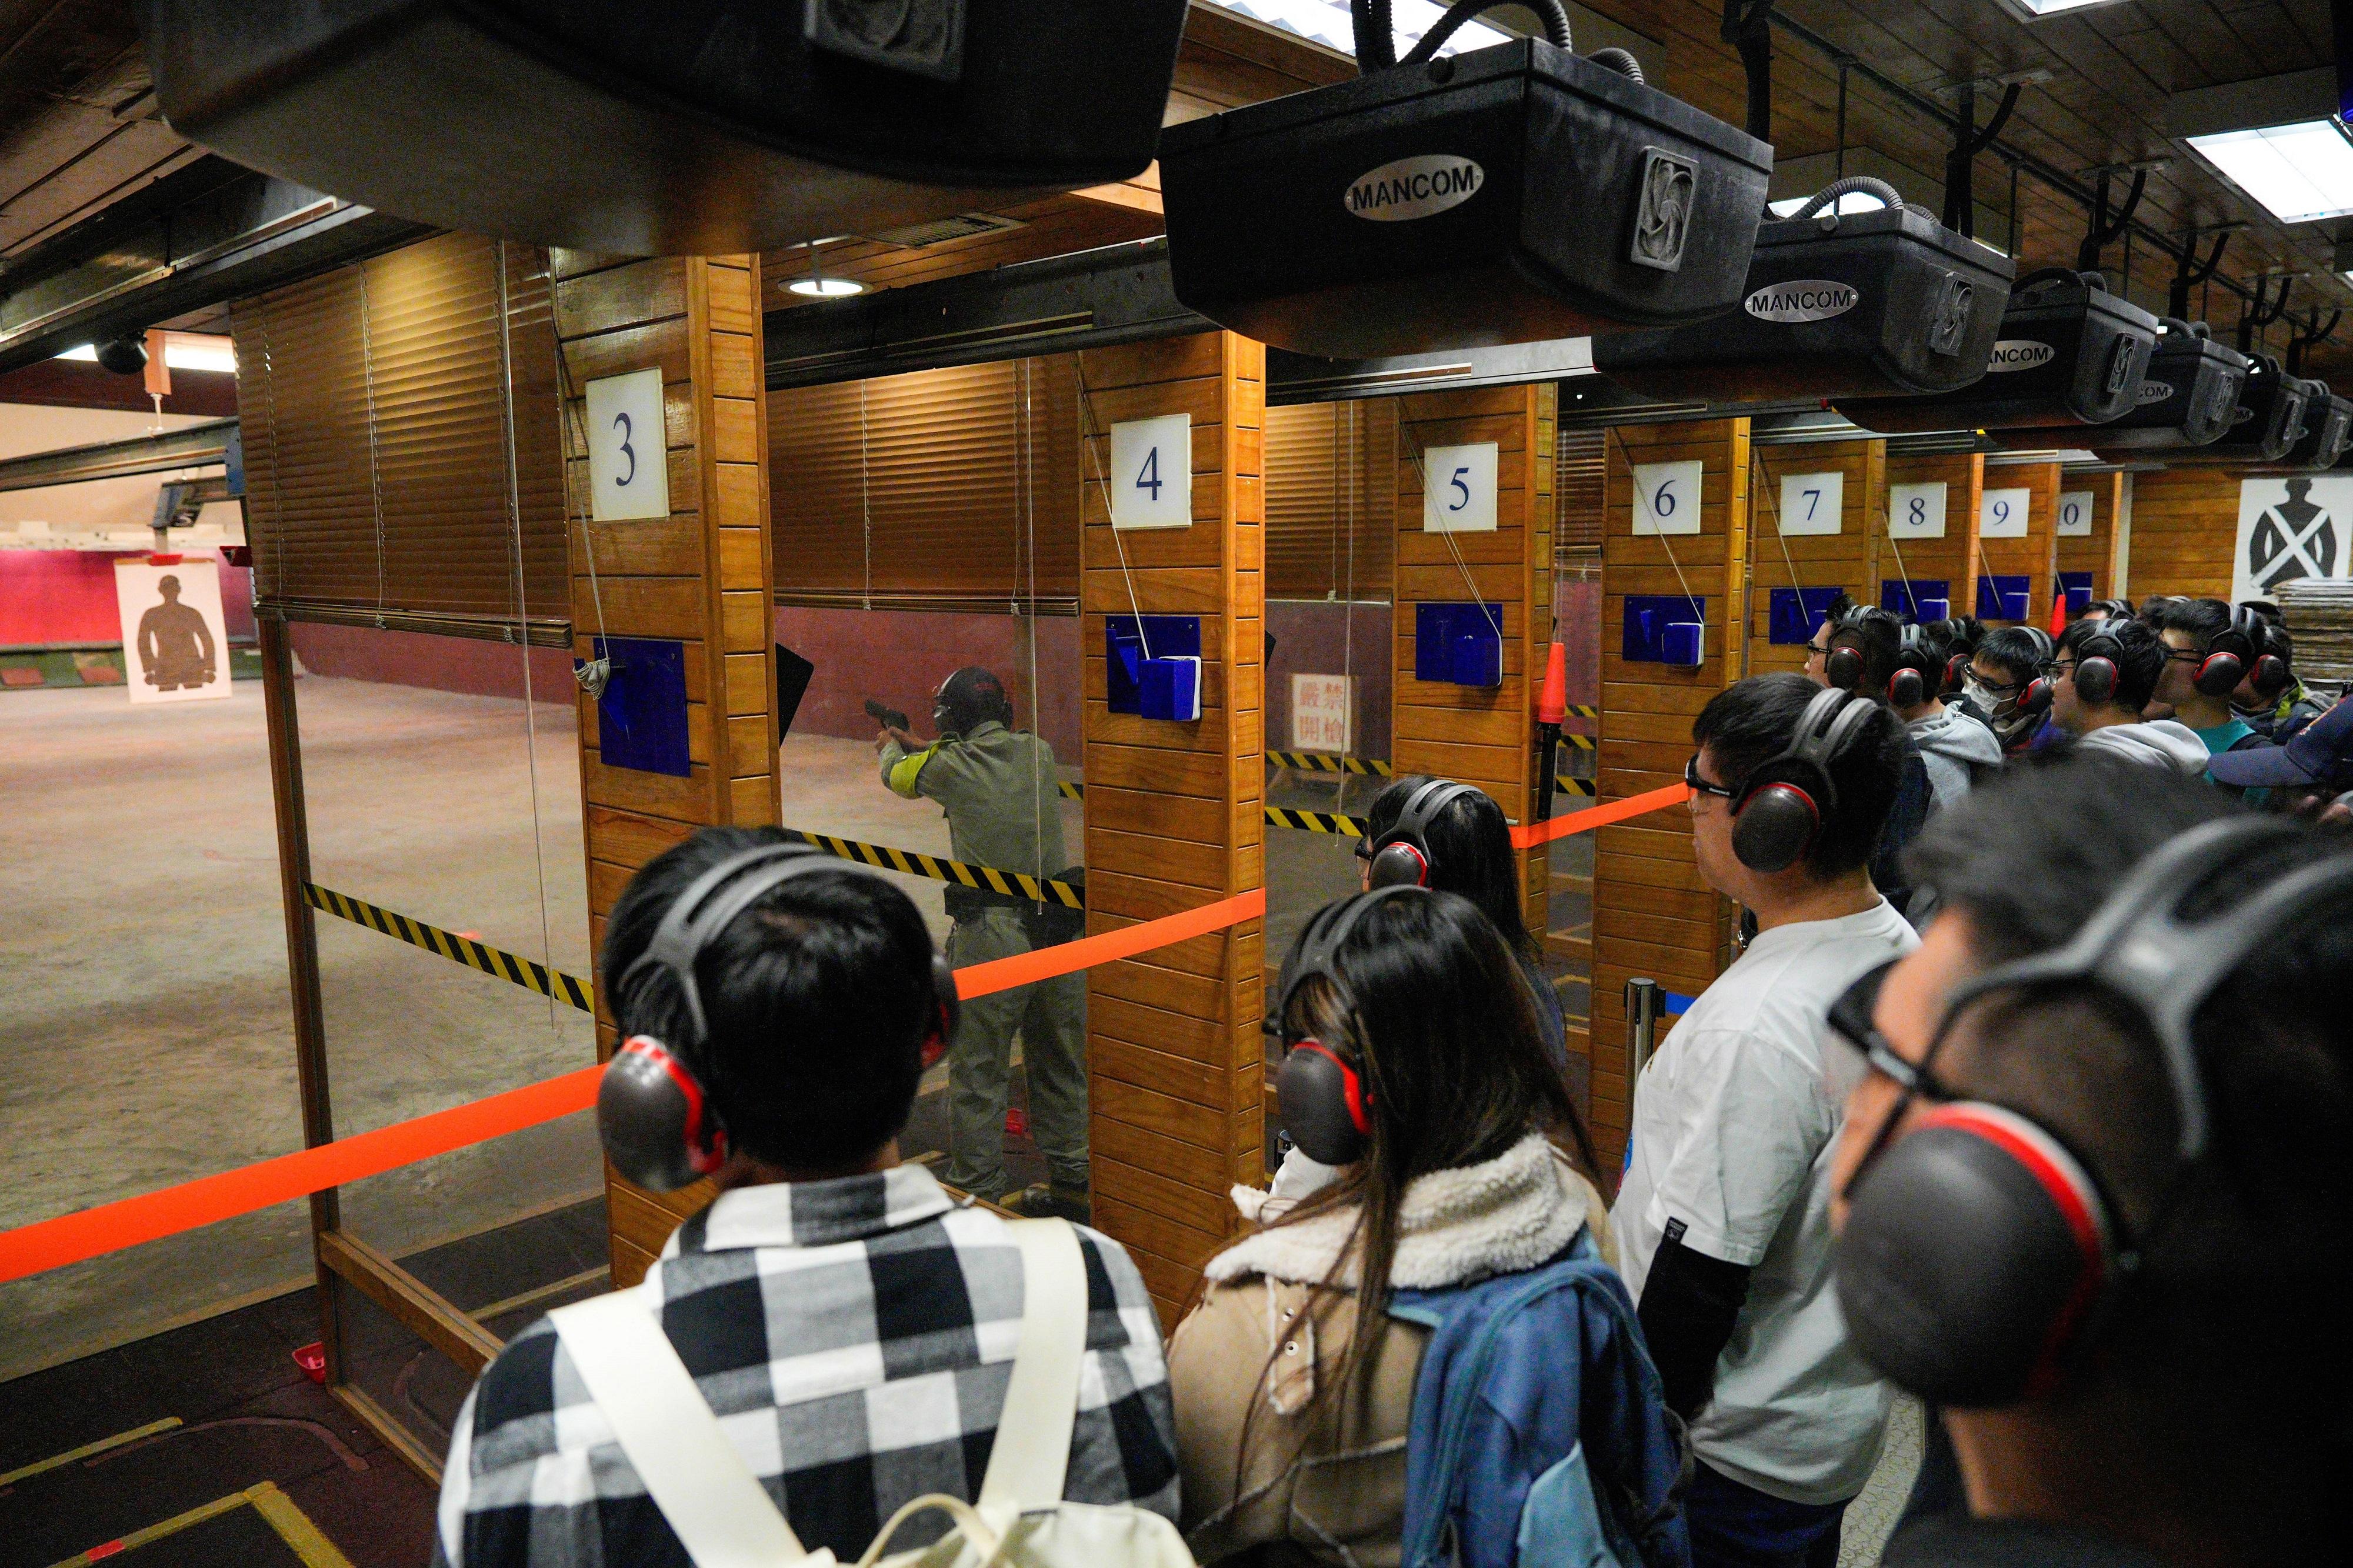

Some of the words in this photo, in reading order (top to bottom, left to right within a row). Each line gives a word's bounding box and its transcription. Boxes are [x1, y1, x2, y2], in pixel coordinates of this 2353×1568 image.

[1352, 165, 1474, 211] MANCOM
[1752, 290, 1851, 312] MANCOM
[613, 412, 635, 487] 3
[1136, 446, 1162, 501] 4
[1449, 467, 1469, 511] 5
[1654, 480, 1676, 517] 6
[1802, 489, 1821, 521] 7
[1909, 497, 1925, 525] 8
[1993, 501, 2009, 525] 9
